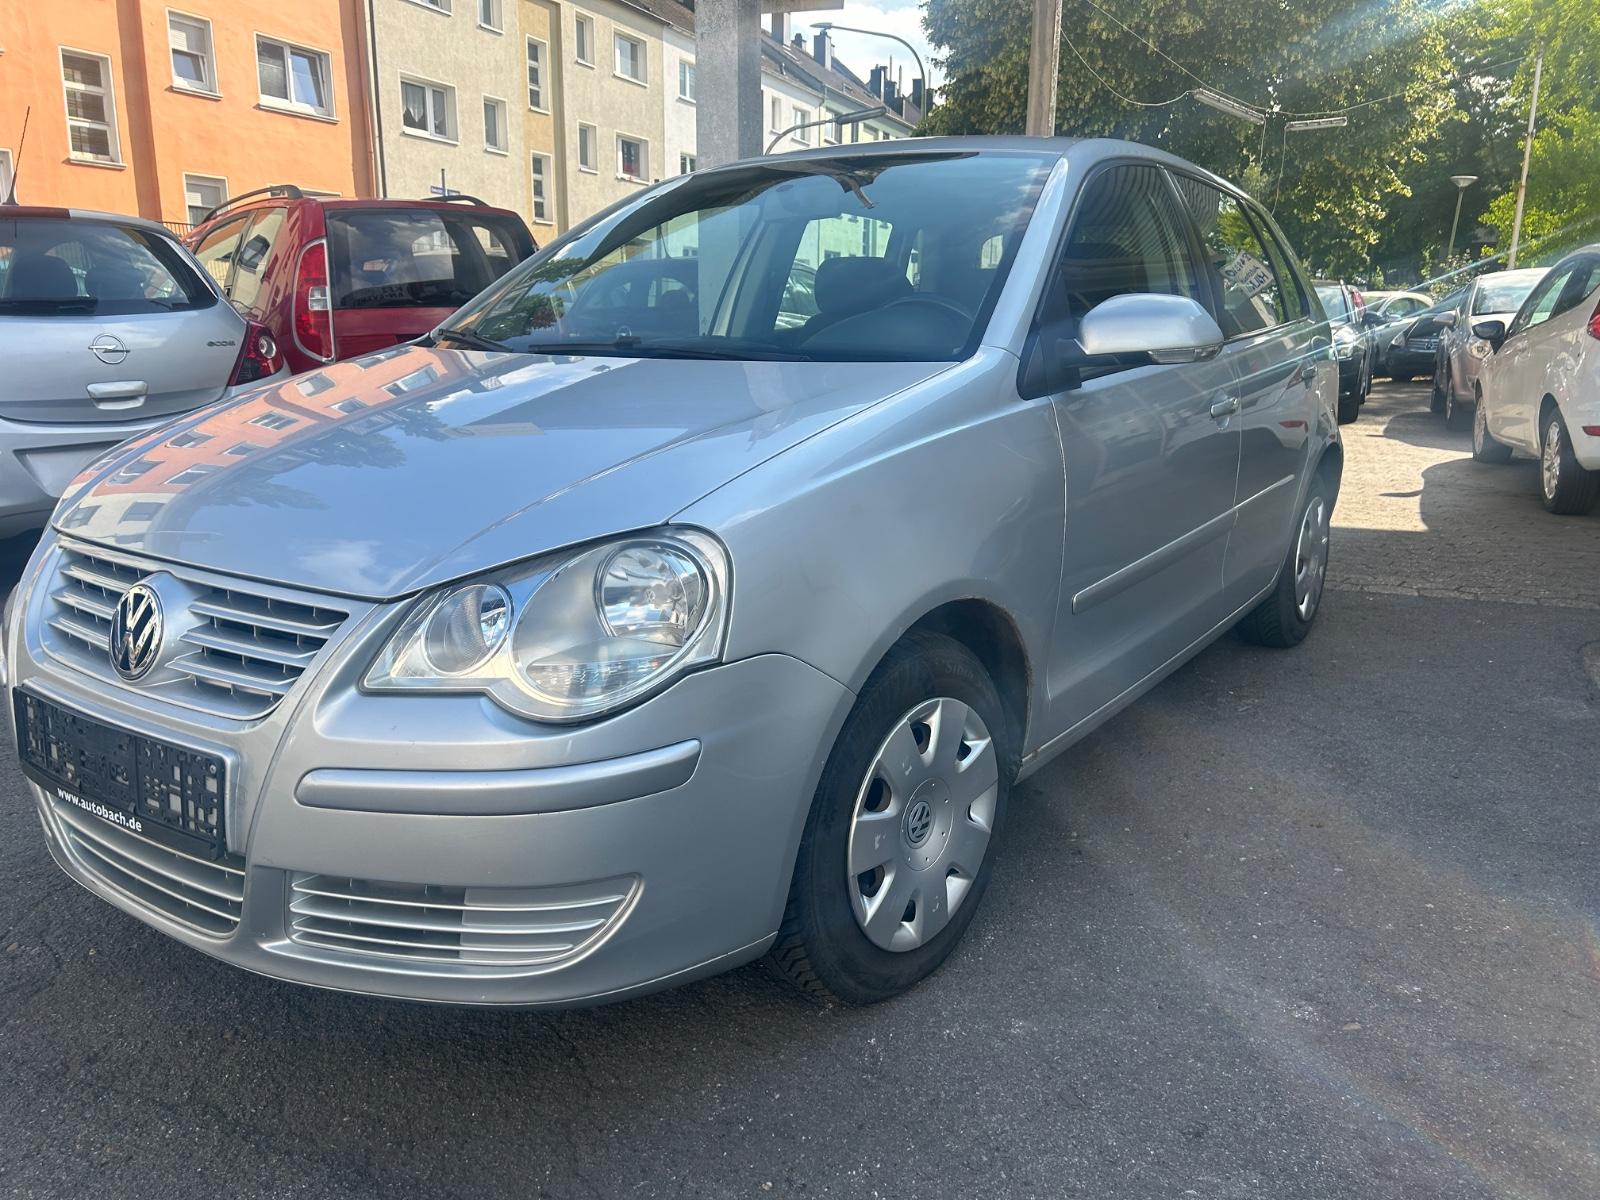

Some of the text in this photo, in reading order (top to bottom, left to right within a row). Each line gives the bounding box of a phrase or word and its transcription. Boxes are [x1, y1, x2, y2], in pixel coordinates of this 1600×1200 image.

[112, 584, 161, 678] VW
[57, 787, 142, 832] www.autobach.de
[907, 801, 931, 843] VW
